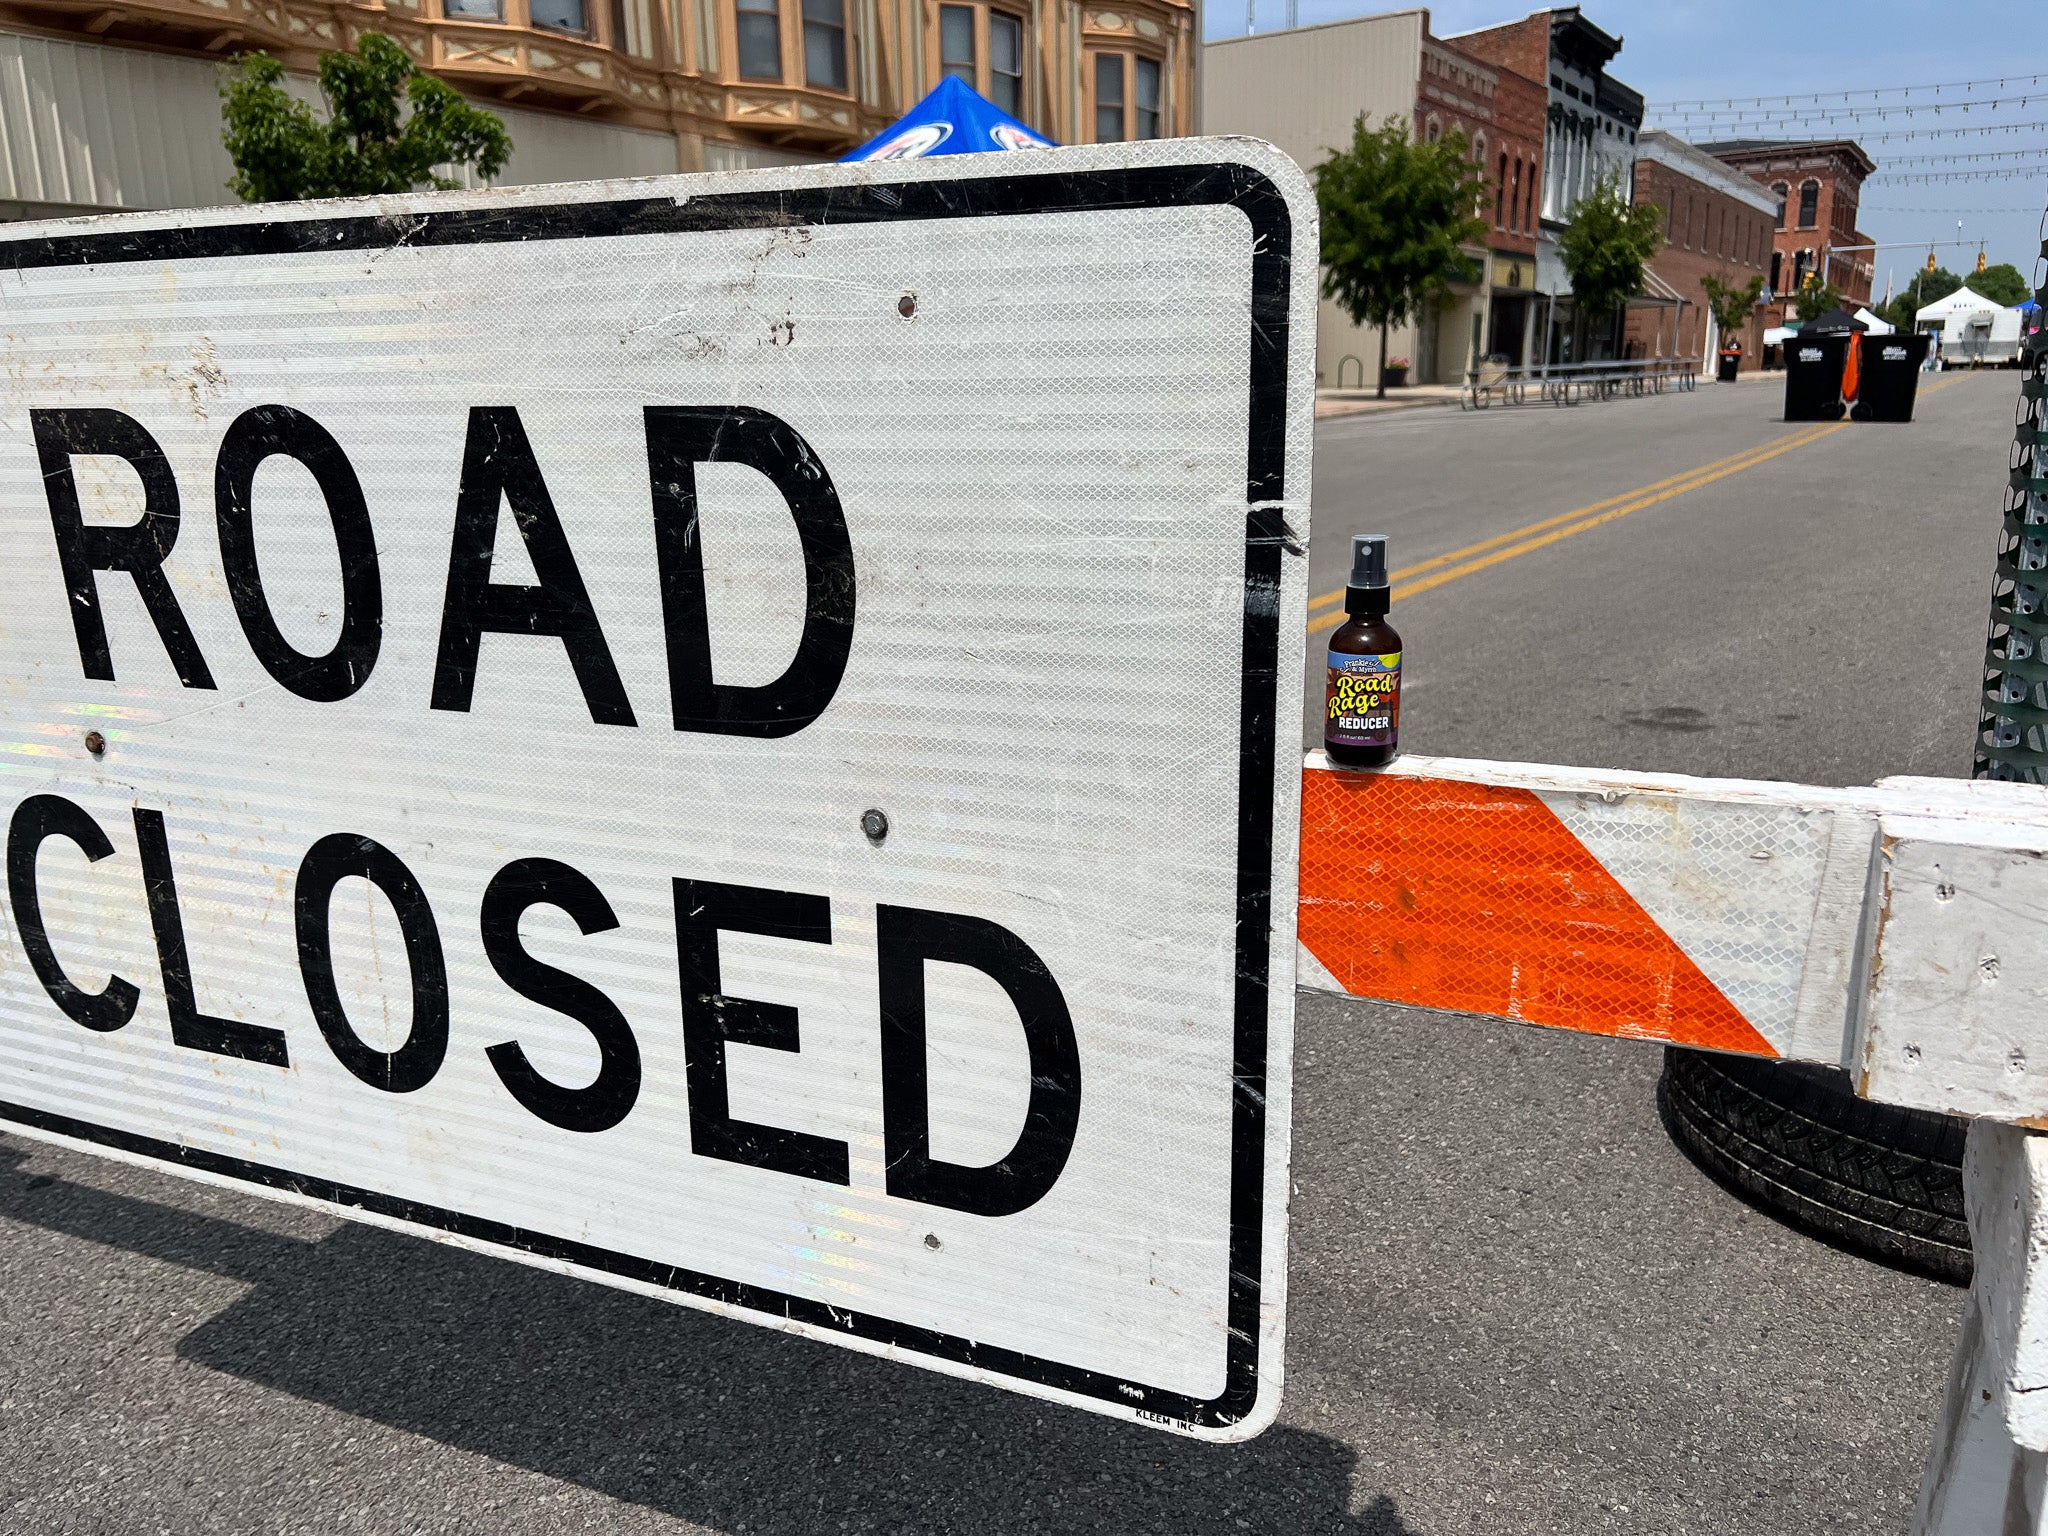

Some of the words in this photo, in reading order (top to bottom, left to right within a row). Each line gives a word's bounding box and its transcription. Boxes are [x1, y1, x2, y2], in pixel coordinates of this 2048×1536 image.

[29, 404, 857, 740] ROAD
[1336, 675, 1392, 698] Road
[1329, 695, 1380, 719] Rage
[1338, 716, 1389, 730] REDUCER
[7, 794, 1082, 1217] CLOSED
[1136, 1409, 1170, 1425] KLEEM
[1177, 1421, 1195, 1432] INC
